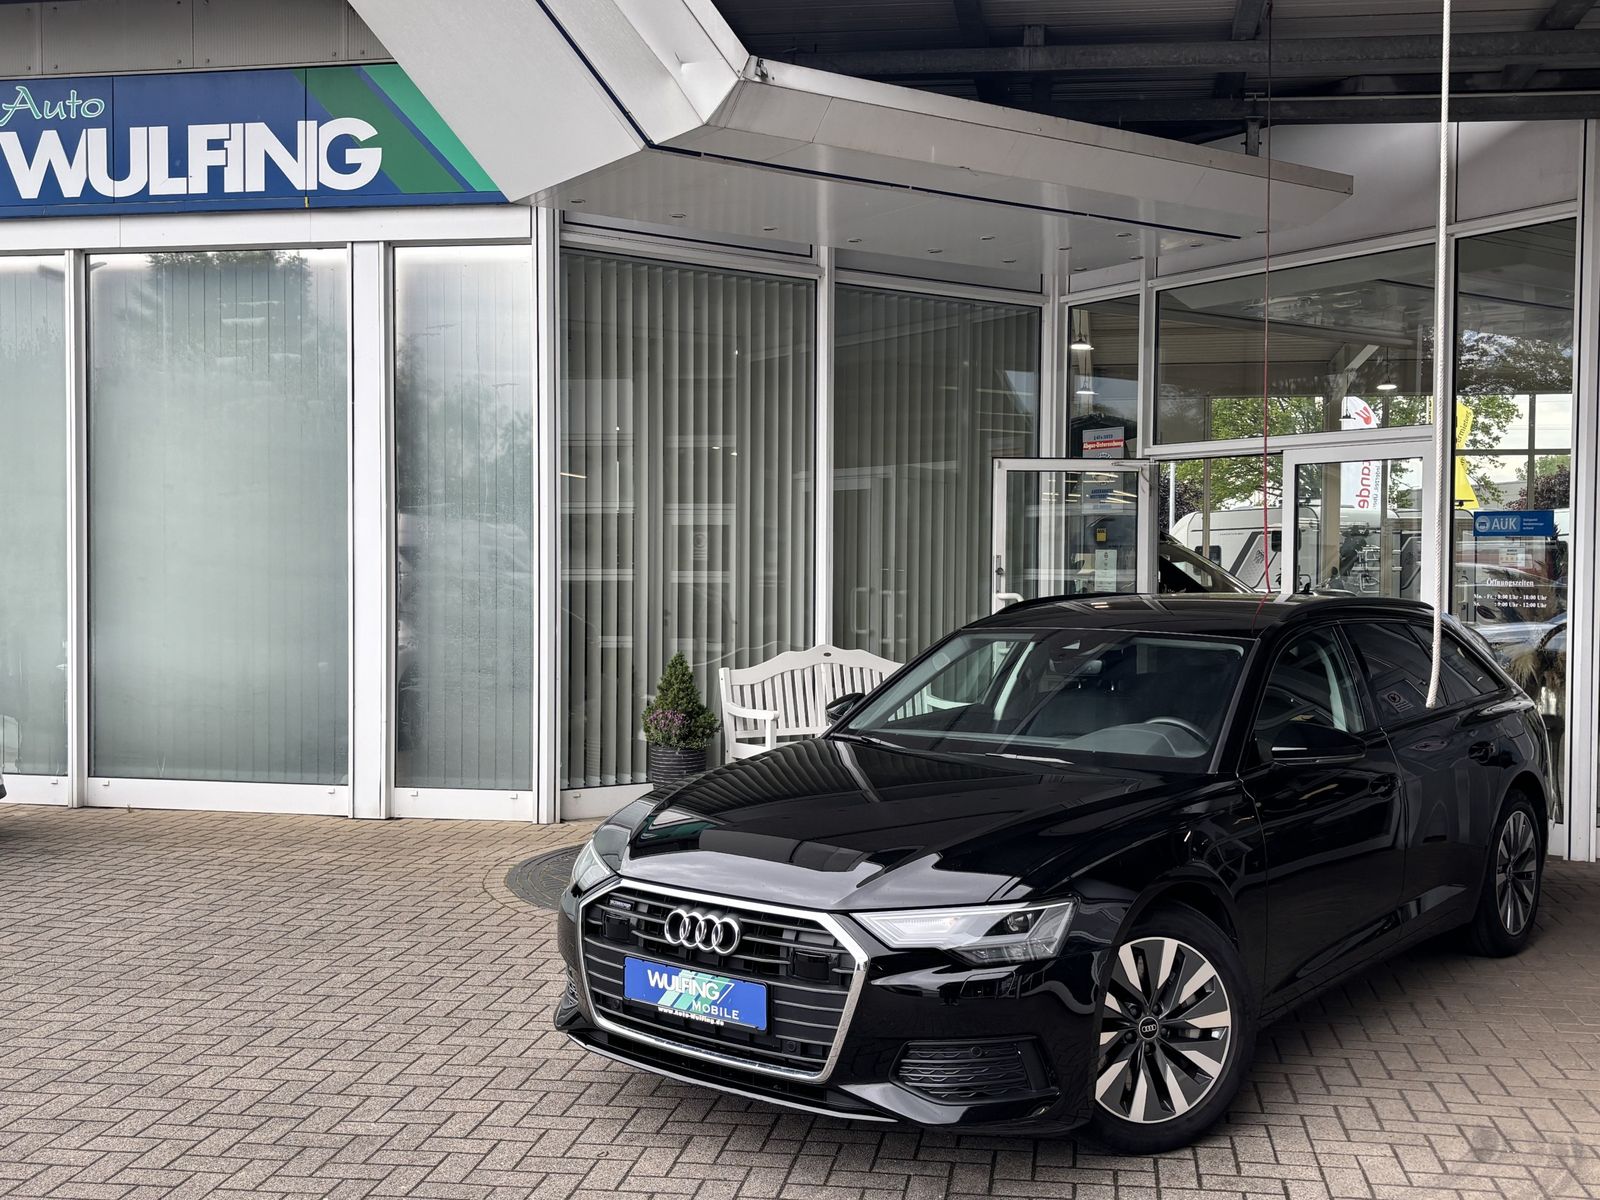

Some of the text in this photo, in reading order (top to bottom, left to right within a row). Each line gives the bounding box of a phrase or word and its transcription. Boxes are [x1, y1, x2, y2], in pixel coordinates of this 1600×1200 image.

[0, 86, 105, 126] Auto
[0, 117, 383, 199] WULFING
[1491, 518, 1517, 530] AÜK
[1486, 577, 1535, 587] Öffnungszeiten
[647, 969, 720, 1001] WULFING
[692, 1000, 740, 1020] MOBILE
